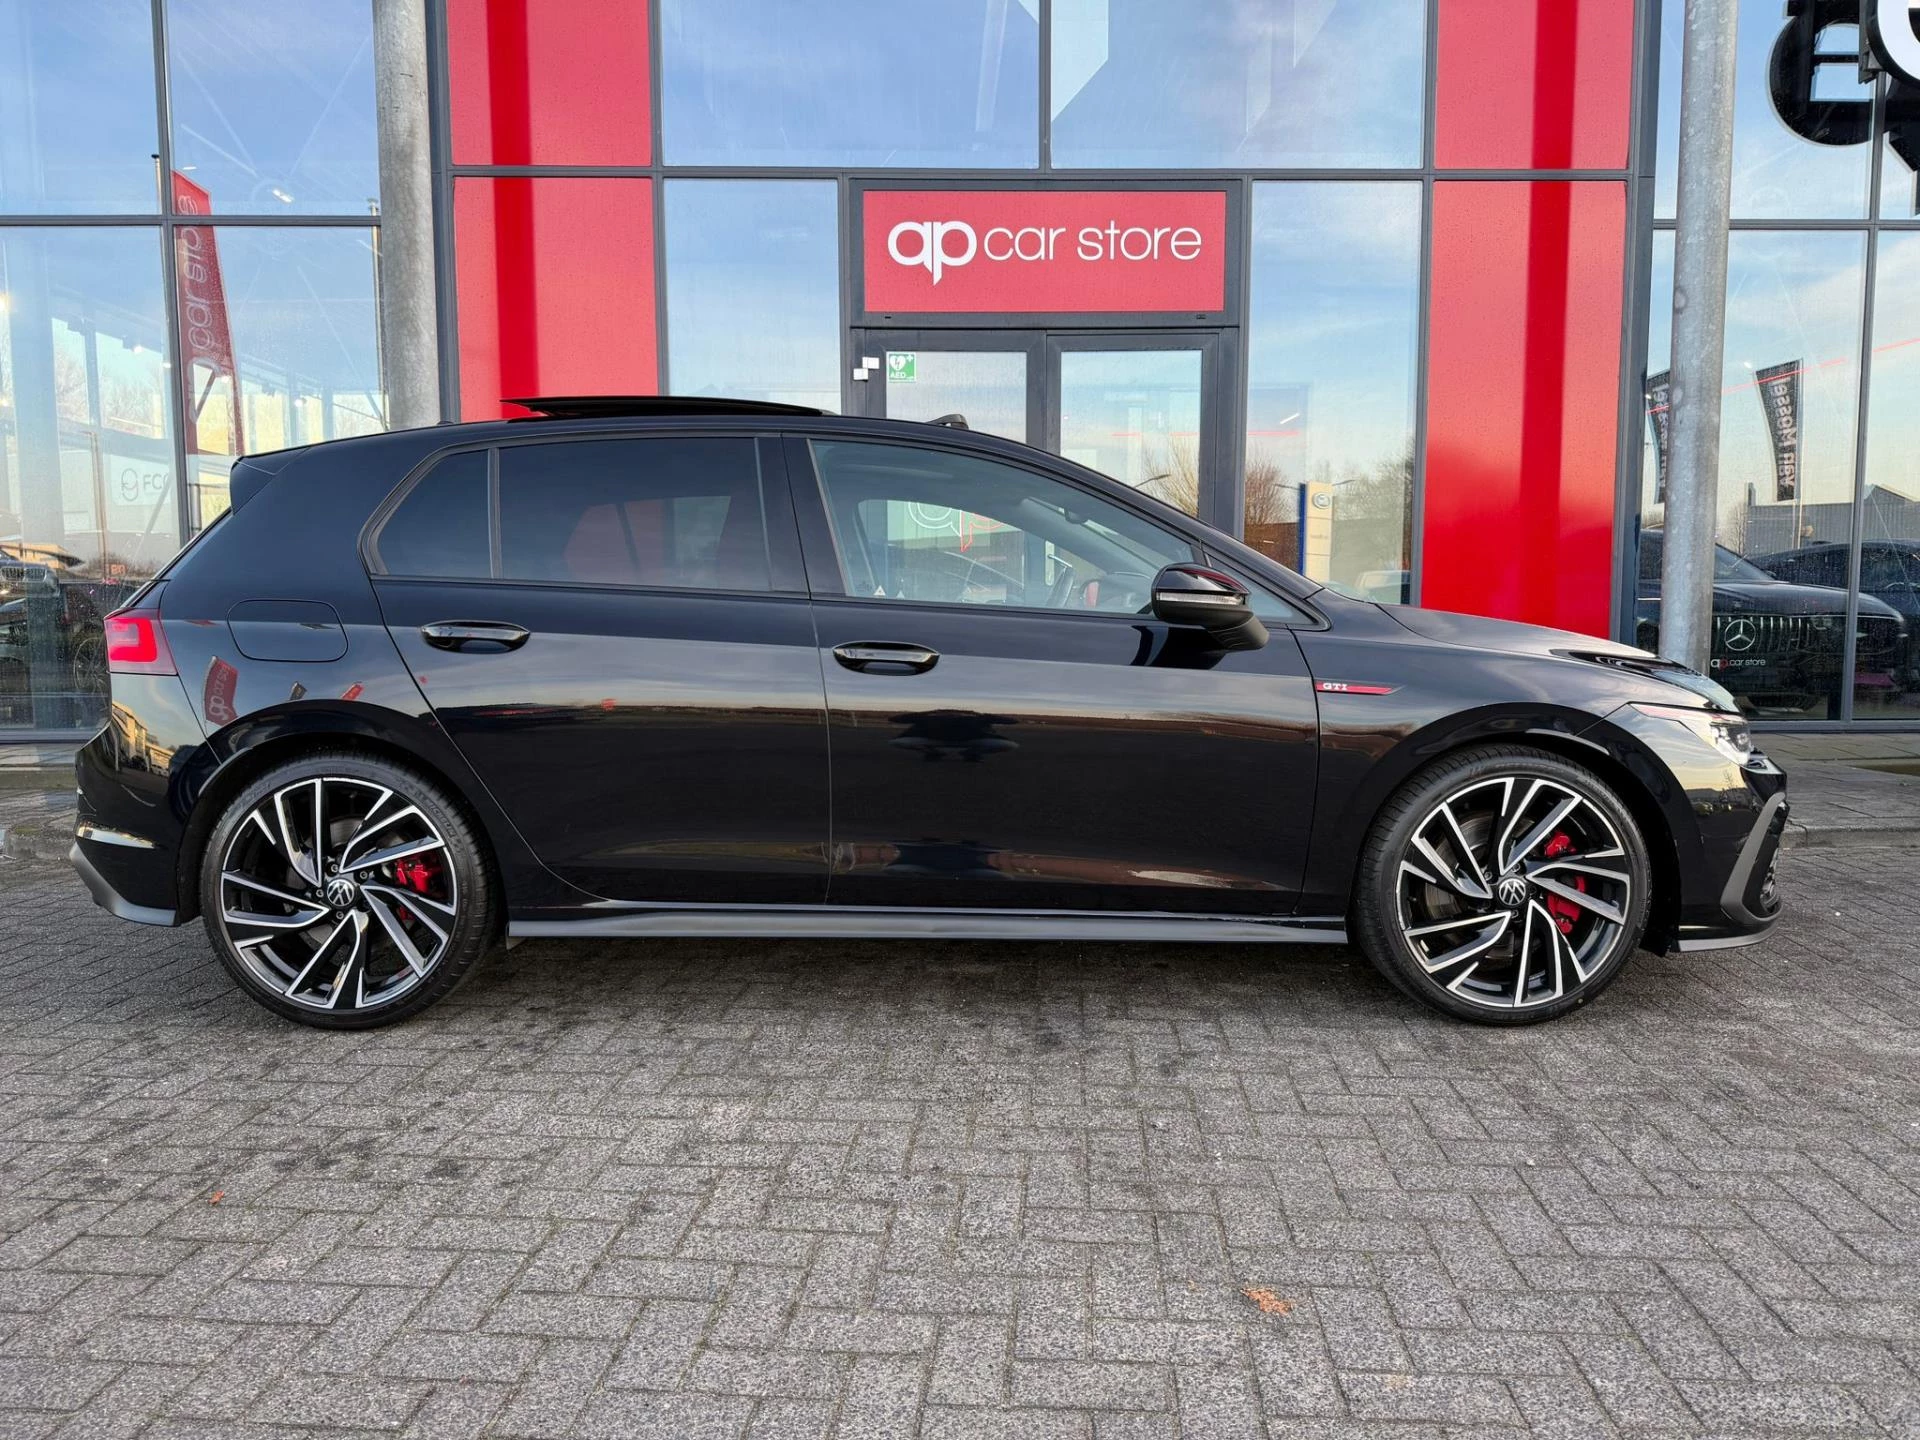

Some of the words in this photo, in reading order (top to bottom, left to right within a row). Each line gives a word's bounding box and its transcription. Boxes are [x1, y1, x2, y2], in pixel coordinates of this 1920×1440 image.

[178, 195, 208, 283] stoe
[888, 221, 977, 286] ap
[984, 227, 1066, 260] car
[1077, 220, 1202, 260] store
[1745, 658, 1766, 666] store
[1322, 682, 1348, 691] GTI
